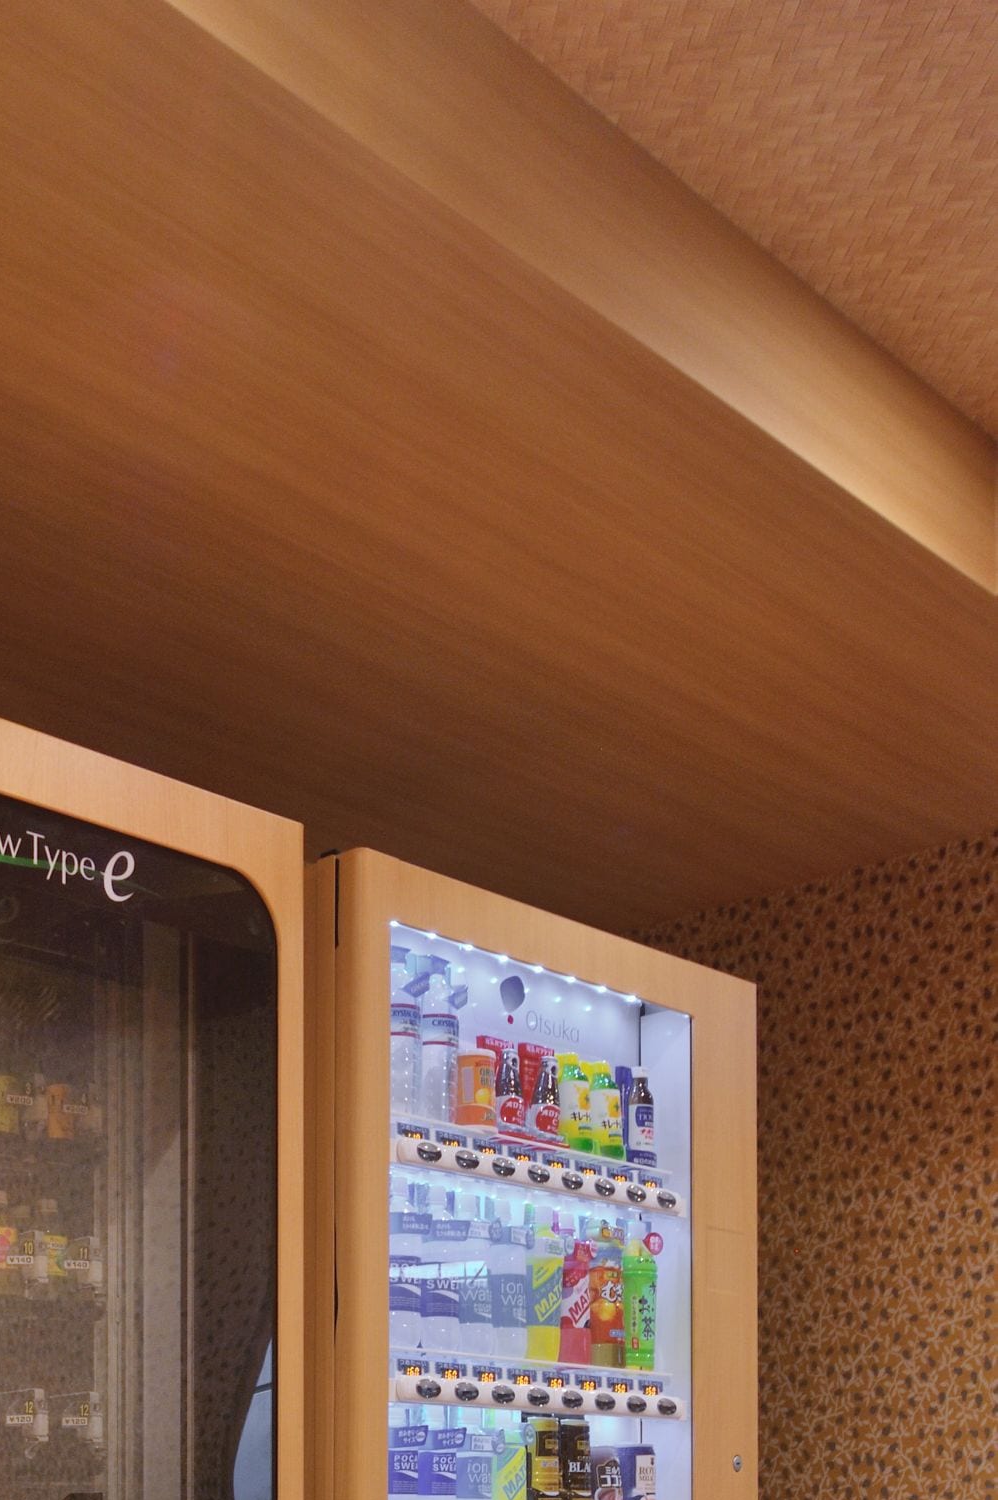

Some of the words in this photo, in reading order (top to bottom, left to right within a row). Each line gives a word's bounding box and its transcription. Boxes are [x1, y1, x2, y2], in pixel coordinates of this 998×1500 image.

[26, 830, 96, 885] Type
[101, 850, 135, 902] e
[525, 1010, 580, 1042] Otsuka
[24, 1242, 33, 1255] 10
[80, 1248, 88, 1260] 11
[501, 1279, 524, 1294] ion
[25, 1401, 34, 1414] 12
[80, 1404, 89, 1416] 12
[64, 1417, 86, 1425] ¥120
[467, 1460, 488, 1473] ion
